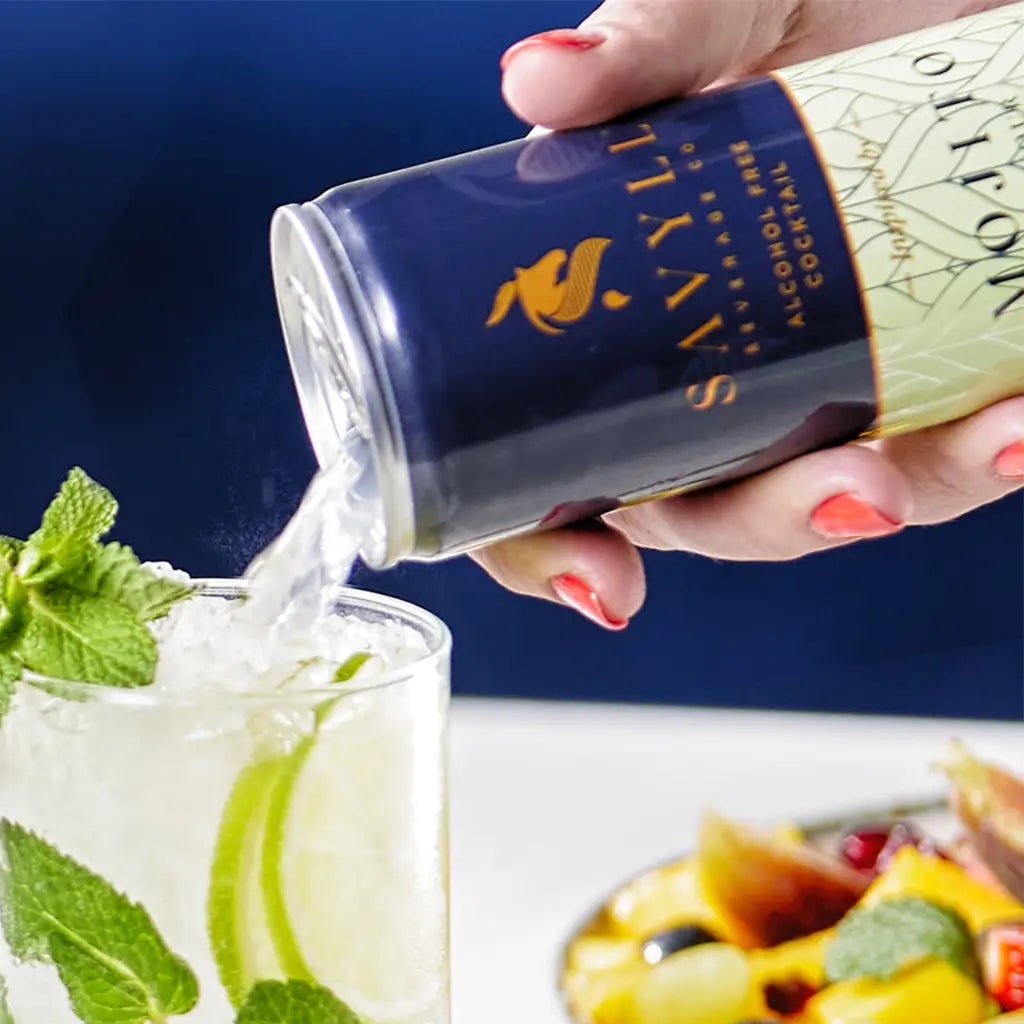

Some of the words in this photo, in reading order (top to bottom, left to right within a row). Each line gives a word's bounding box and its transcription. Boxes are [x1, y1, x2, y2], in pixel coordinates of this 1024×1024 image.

[729, 140, 768, 197] FREE
[770, 160, 824, 290] COCKTAIL
[606, 122, 738, 411] SAVYLL
[758, 206, 806, 328] ALCOHOL
